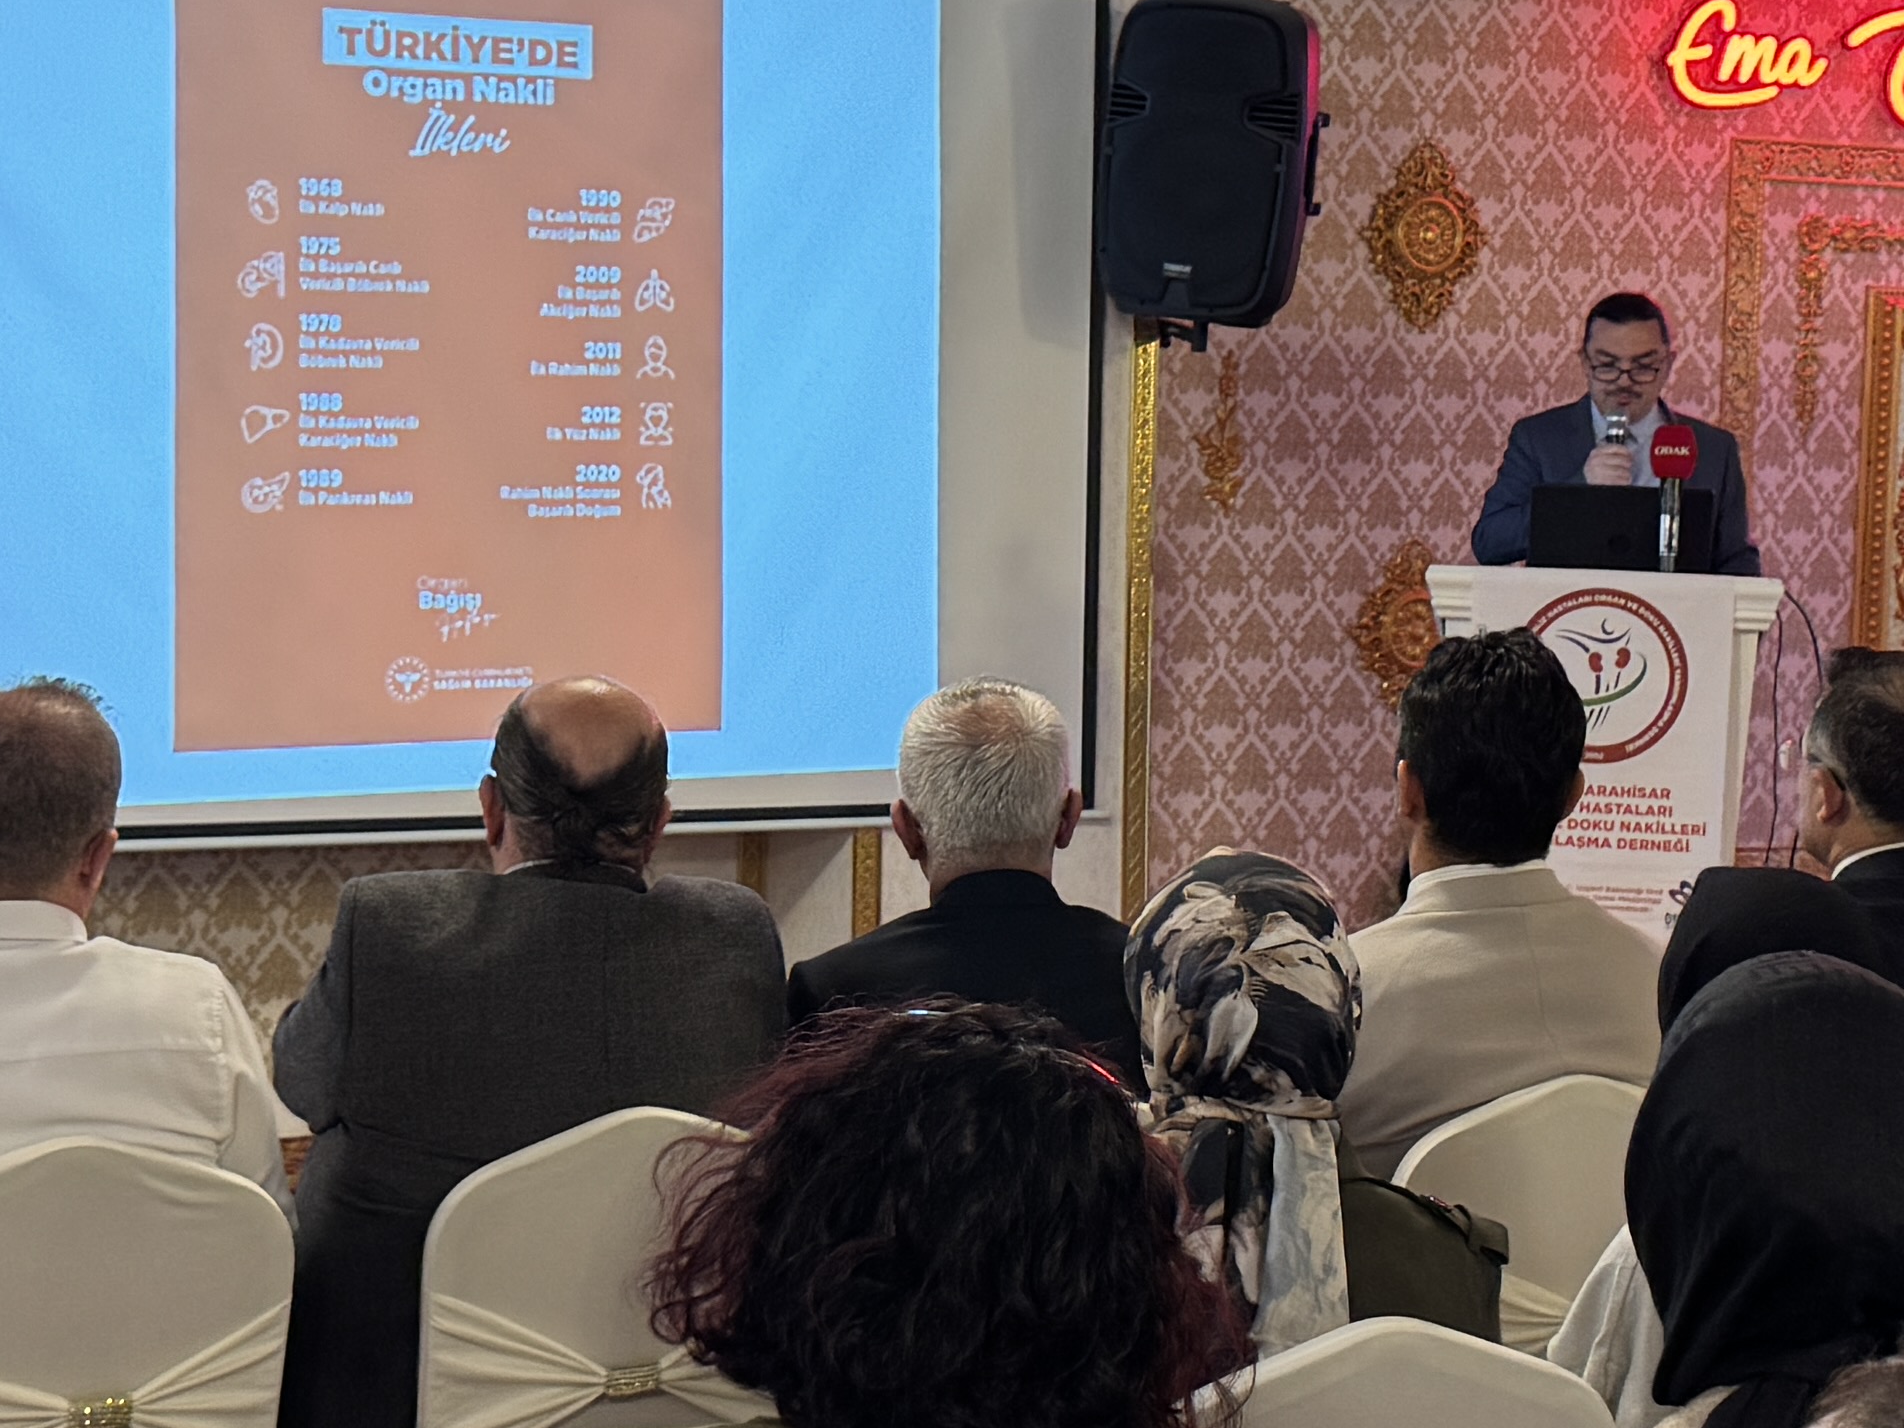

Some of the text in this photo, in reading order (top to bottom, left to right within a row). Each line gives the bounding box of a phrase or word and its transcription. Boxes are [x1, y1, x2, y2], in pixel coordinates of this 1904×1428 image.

[337, 19, 579, 69] TÜRKİYE'DE
[362, 69, 555, 105] Organ Nakli
[408, 101, 511, 157] İlkleri
[299, 235, 341, 256] 1975
[584, 341, 622, 360] 2011
[581, 406, 622, 425] 2012
[575, 464, 621, 483] 2020
[1584, 784, 1671, 801] ARAHİSAR
[1579, 801, 1673, 818] HASTALARI
[1567, 818, 1706, 837] DOKU NAKİLLERİ
[1616, 837, 1691, 853] DERNEĞİ
